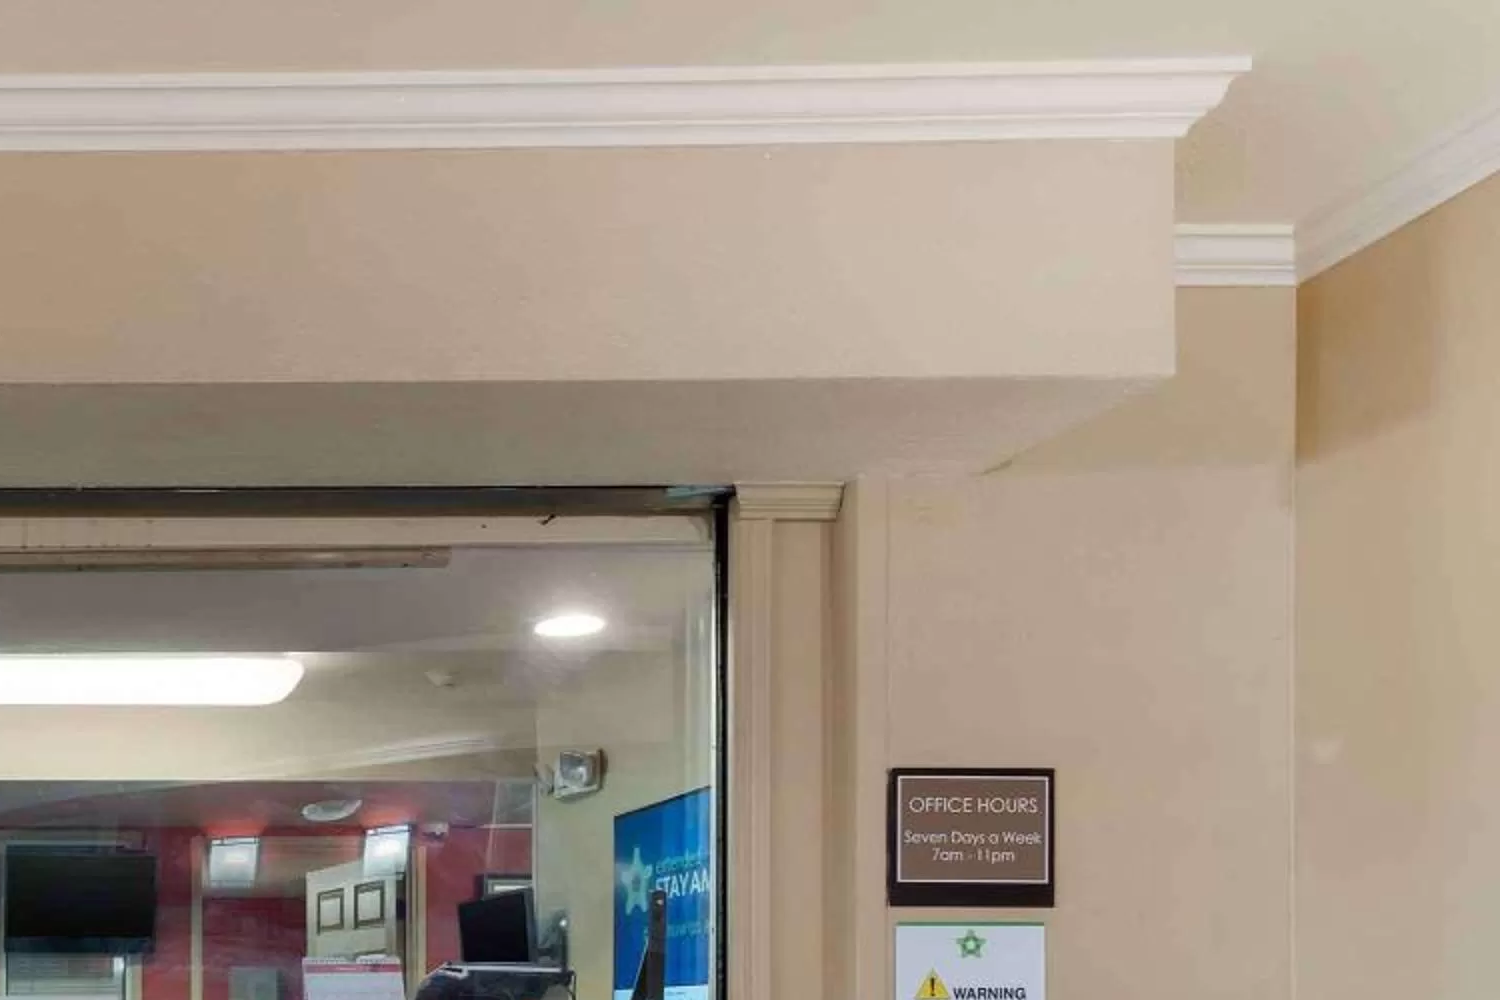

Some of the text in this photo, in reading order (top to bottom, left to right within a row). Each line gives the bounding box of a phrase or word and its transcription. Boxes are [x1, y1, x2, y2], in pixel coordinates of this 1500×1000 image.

[909, 797, 1038, 814] OFFICE HOURS
[903, 830, 1043, 847] Seven Days a Week
[931, 848, 964, 862] 7am
[977, 848, 1016, 865] 11pm
[952, 987, 1027, 1000] WARNING
